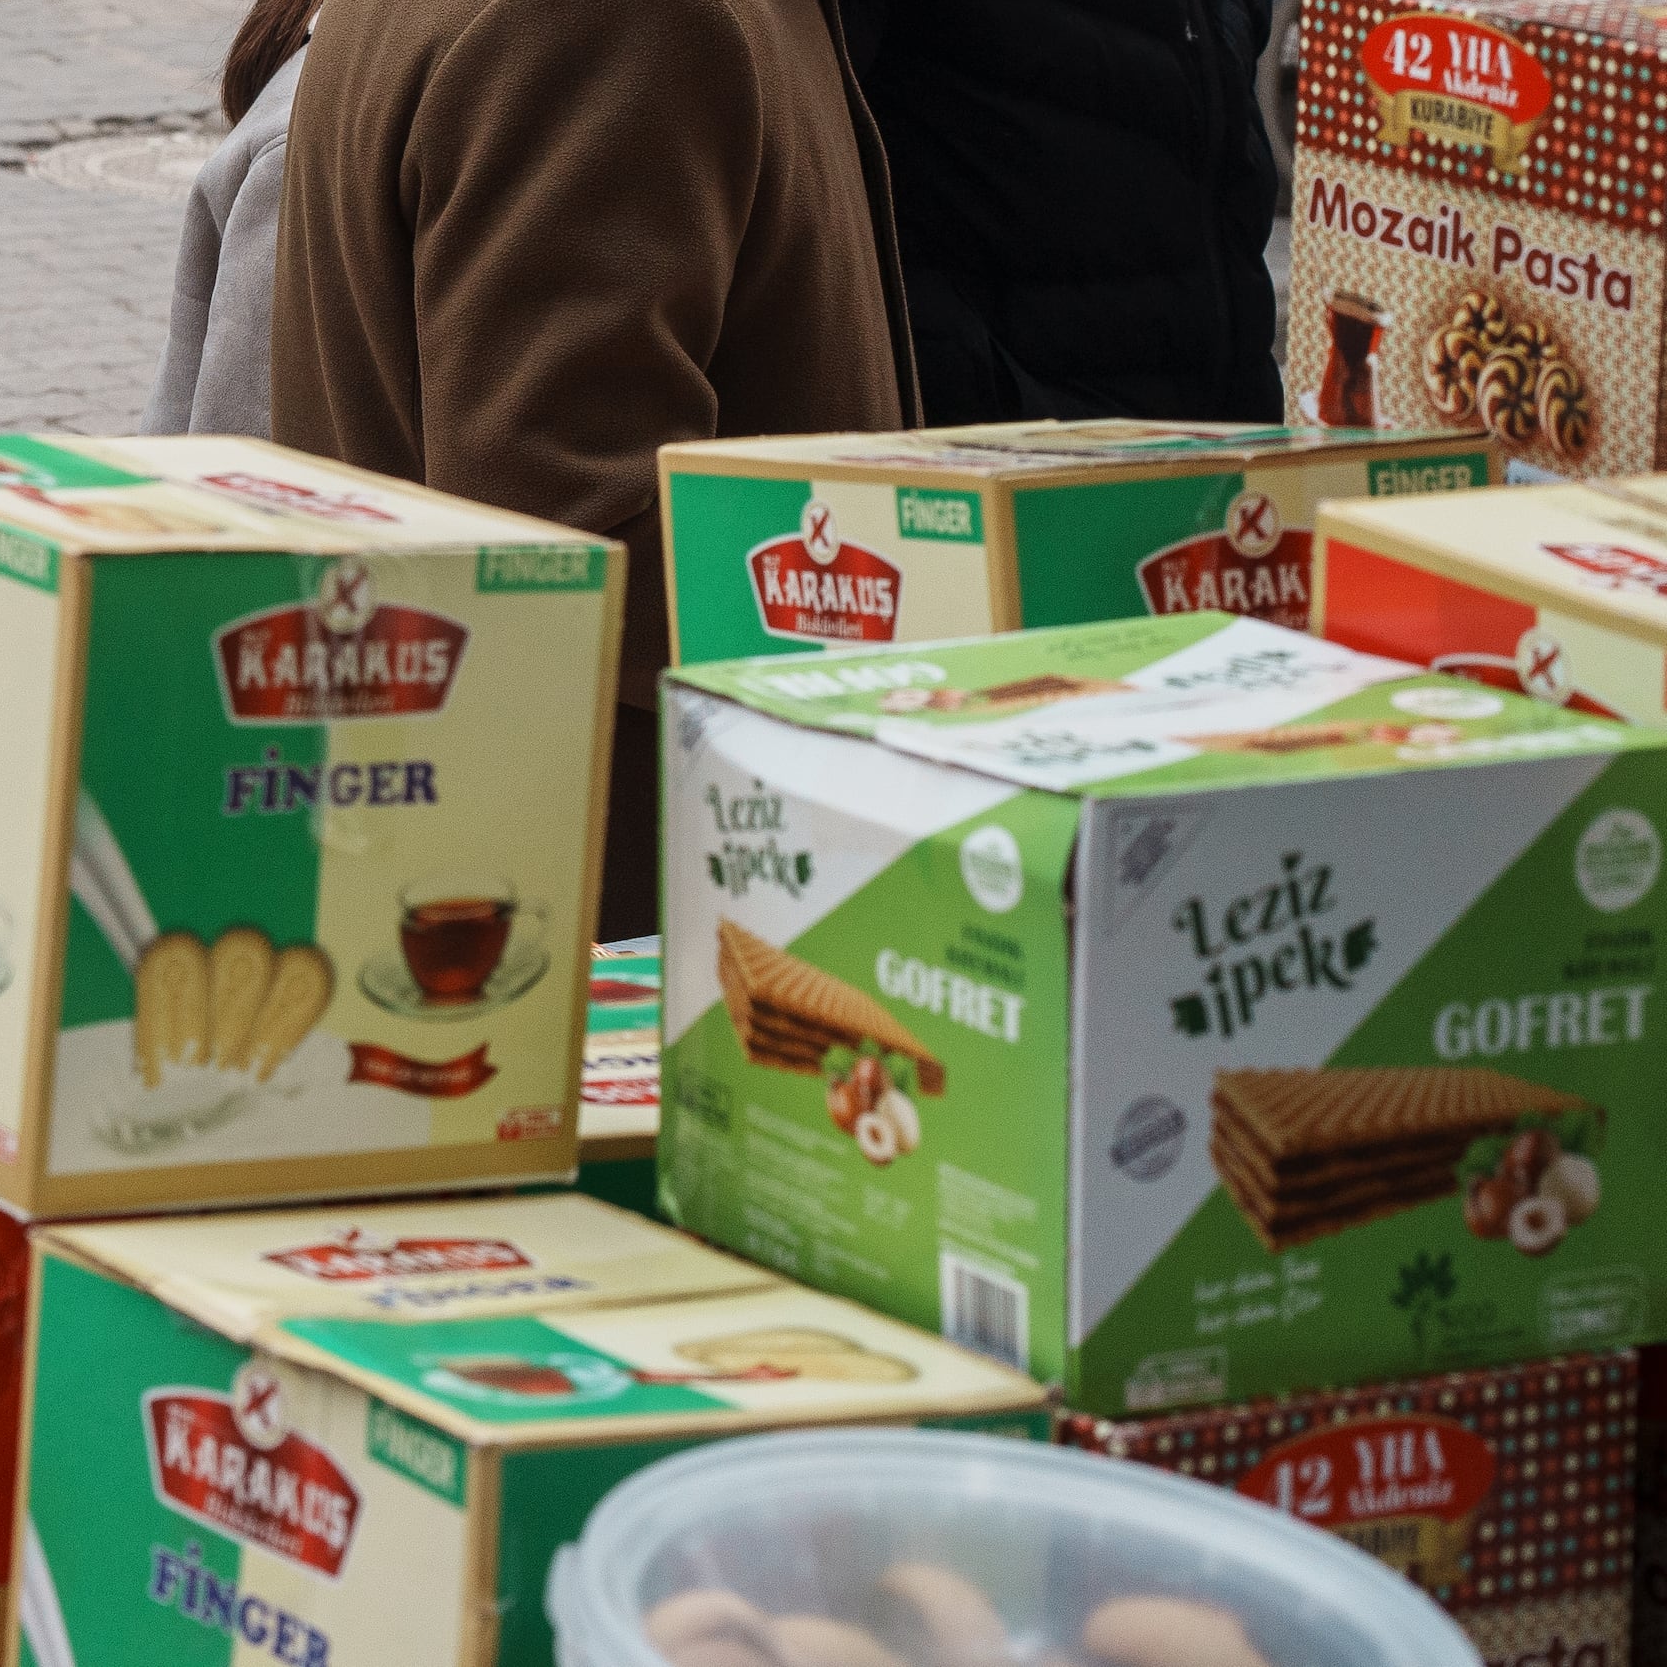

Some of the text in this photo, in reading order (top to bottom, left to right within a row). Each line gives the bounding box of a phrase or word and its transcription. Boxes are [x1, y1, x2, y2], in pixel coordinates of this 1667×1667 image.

[1308, 177, 1635, 313] Mozaik Pasta
[763, 561, 896, 622] KARAKUŞ
[222, 745, 439, 816] FİNGER
[875, 947, 1027, 1045] GOFRET
[1433, 984, 1655, 1061] GOFRET
